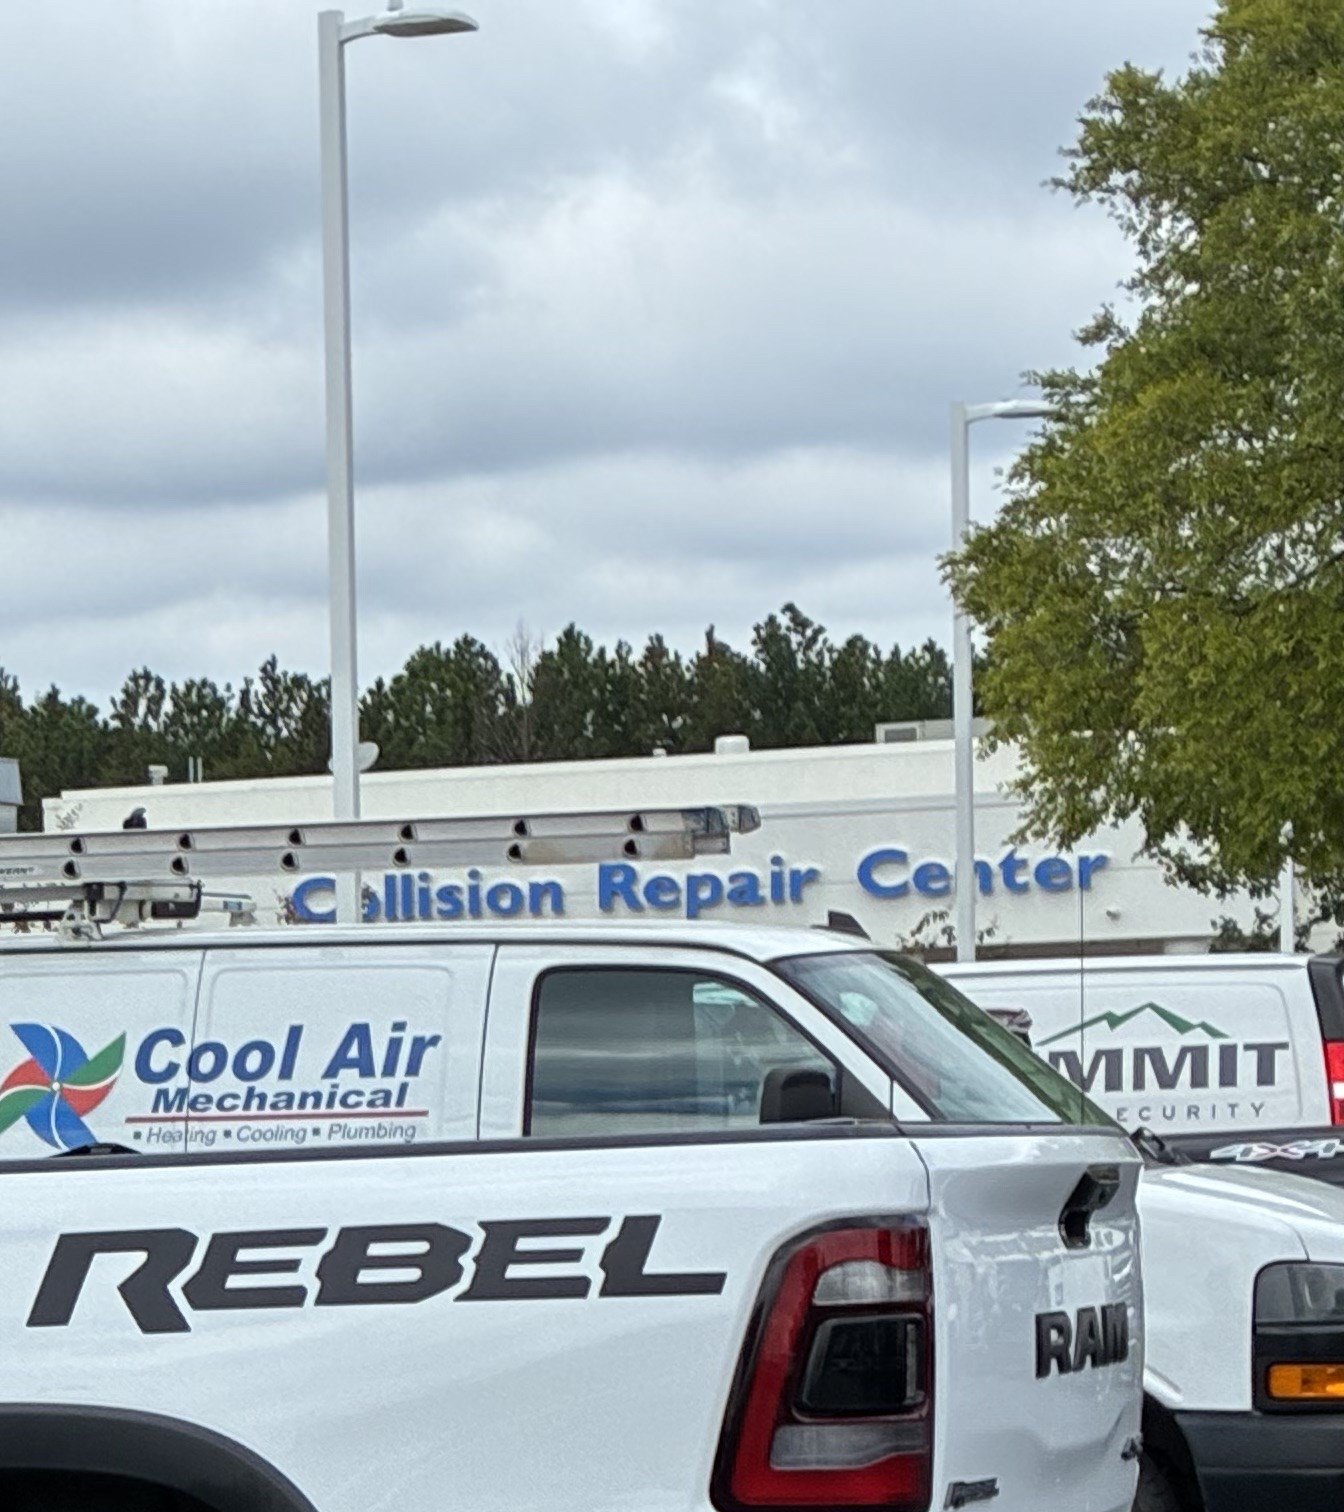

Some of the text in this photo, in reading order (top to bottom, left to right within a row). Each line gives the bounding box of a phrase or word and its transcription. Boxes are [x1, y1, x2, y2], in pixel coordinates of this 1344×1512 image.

[598, 861, 819, 919] Repair
[134, 1021, 441, 1084] Cool Air
[1049, 1043, 1289, 1093] MMIT
[151, 1083, 407, 1114] Mechanical
[1116, 1102, 1265, 1123] ECURITY
[236, 1124, 308, 1143] Cooling
[327, 1122, 416, 1142] Plumbing
[26, 1214, 727, 1333] REBEL
[1035, 1302, 1129, 1378] RAM
